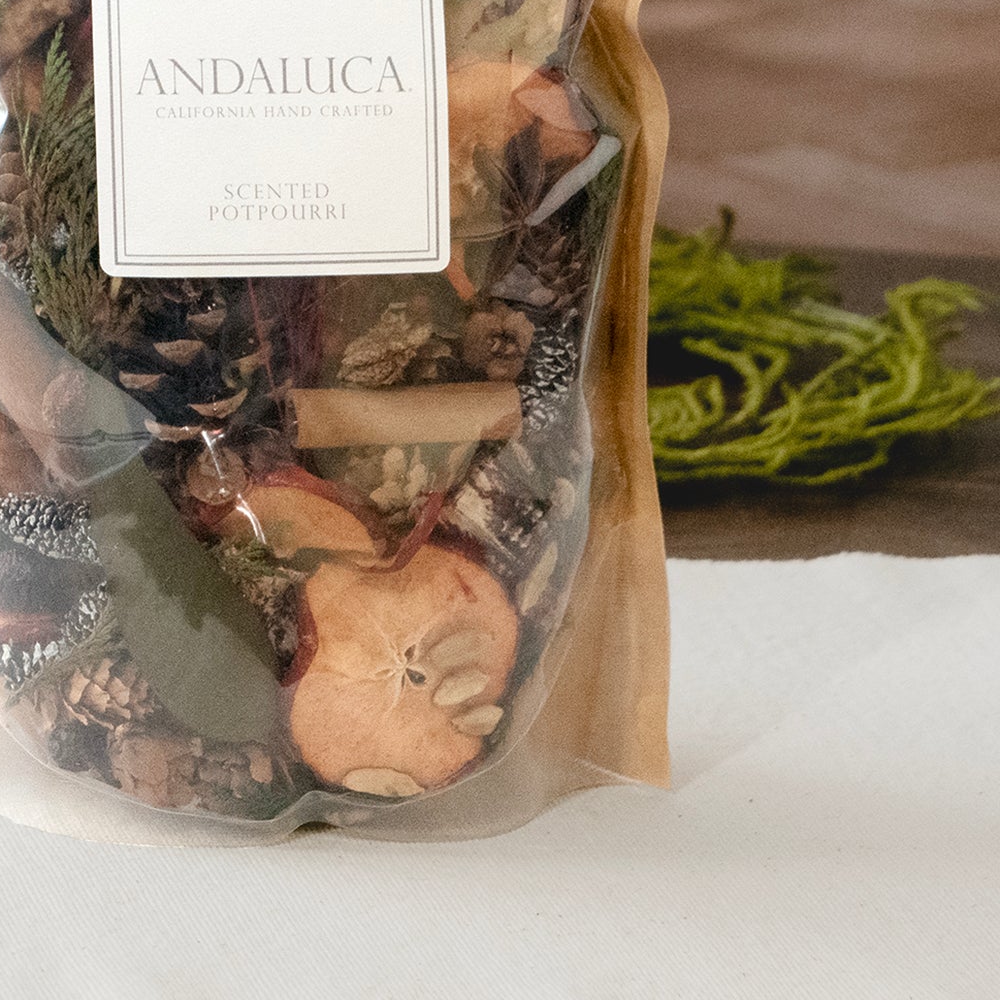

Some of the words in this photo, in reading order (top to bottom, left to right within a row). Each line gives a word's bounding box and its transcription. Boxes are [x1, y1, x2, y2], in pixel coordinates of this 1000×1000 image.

[155, 105, 256, 119] CALIFORNIA
[264, 105, 312, 118] HAND
[319, 104, 394, 117] CRAFTED
[224, 183, 330, 200] SCENTED
[209, 203, 347, 222] POTPOURRI
